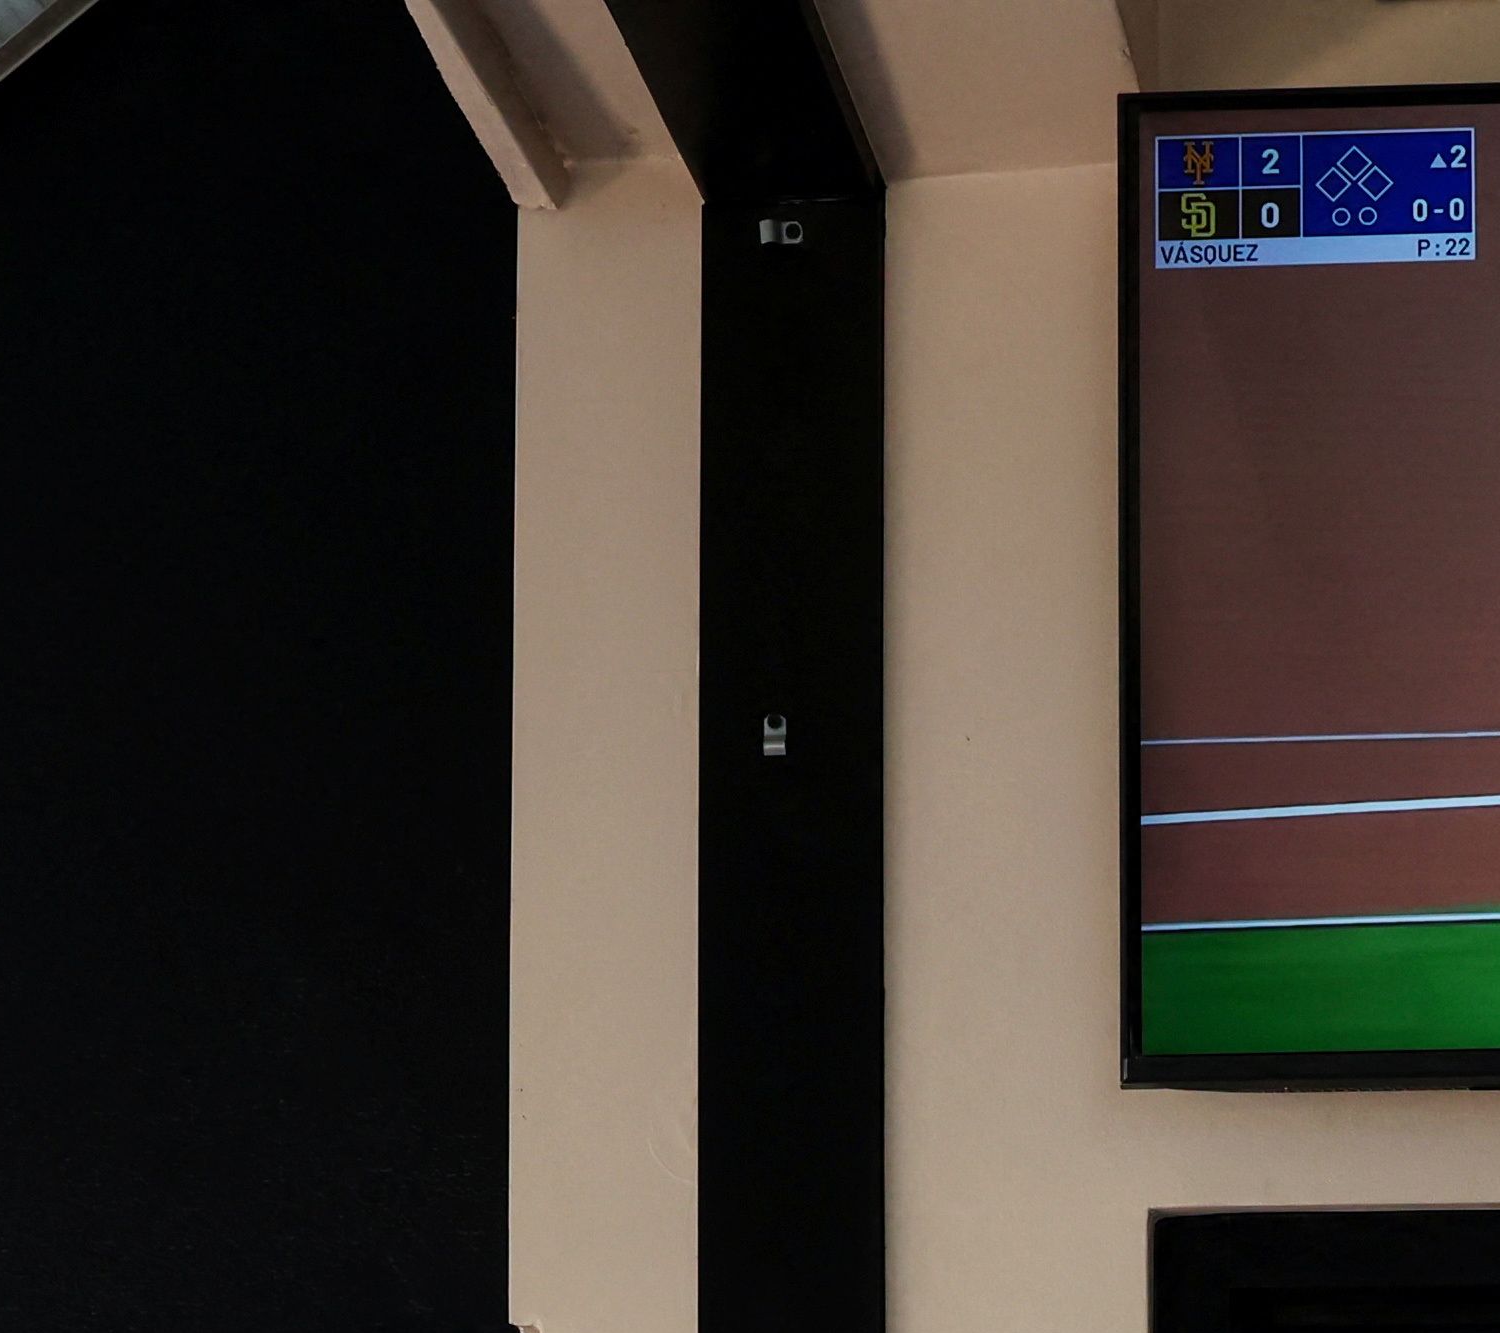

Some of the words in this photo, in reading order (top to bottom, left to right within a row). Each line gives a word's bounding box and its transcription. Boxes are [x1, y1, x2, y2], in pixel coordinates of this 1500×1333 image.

[1261, 149, 1280, 175] 2
[1450, 145, 1467, 168] 2
[1260, 202, 1280, 228] 0
[1412, 198, 1465, 222] 0-0
[1417, 238, 1471, 257] P:22
